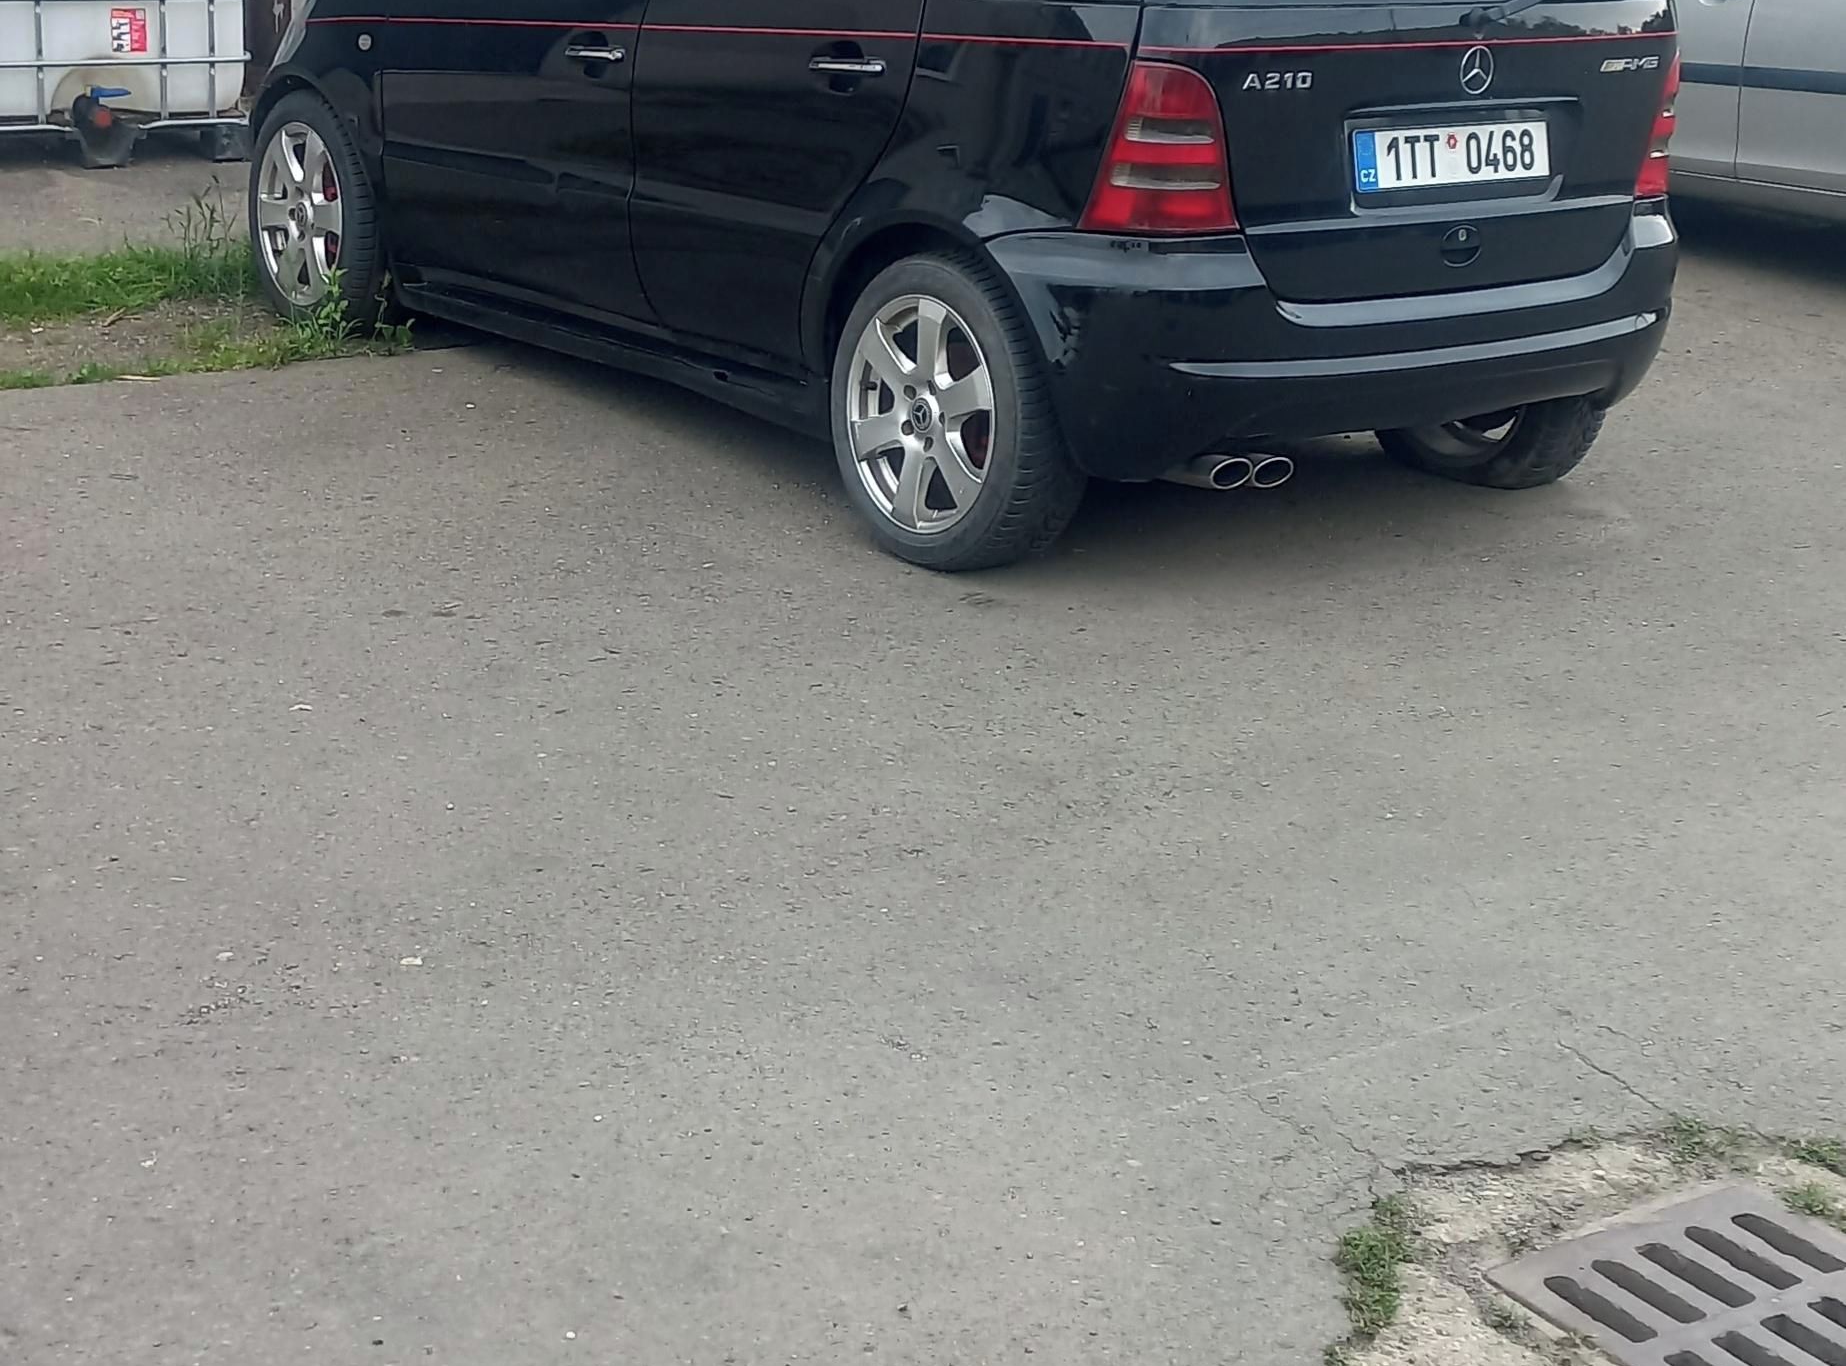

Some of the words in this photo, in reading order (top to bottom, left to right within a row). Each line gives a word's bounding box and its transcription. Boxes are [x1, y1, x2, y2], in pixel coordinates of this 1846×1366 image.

[1614, 56, 1660, 72] AMG
[1242, 71, 1313, 90] A210
[1387, 134, 1440, 181] 1TT
[1466, 128, 1535, 175] 0468
[1360, 170, 1377, 183] CZ
